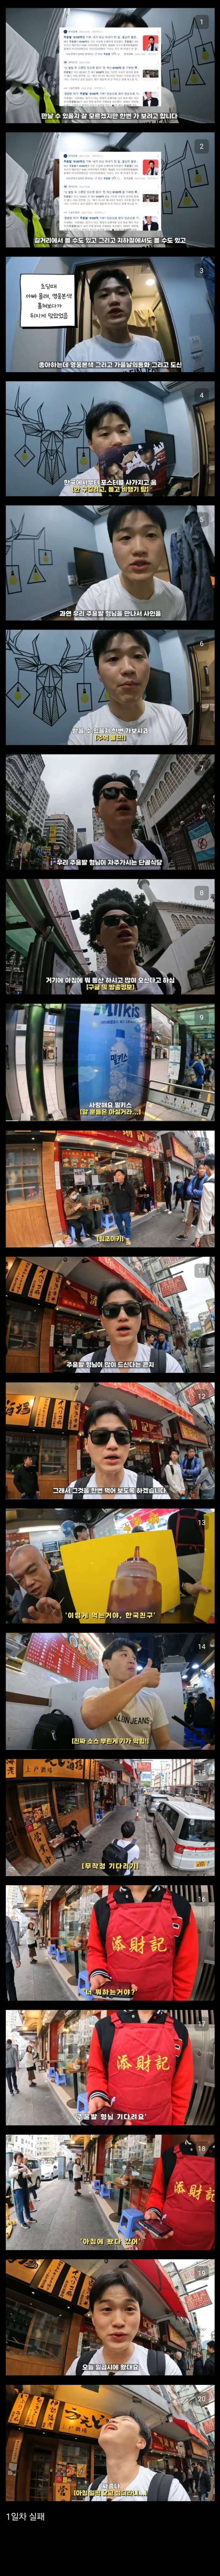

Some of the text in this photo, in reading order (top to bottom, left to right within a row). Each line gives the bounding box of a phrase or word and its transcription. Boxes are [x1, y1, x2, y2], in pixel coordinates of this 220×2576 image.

[48, 889, 74, 949] Cheers Moments
[94, 1004, 140, 1018] Milkis
[111, 1053, 128, 1065] 밀키스
[114, 1714, 130, 1724] KLEIN
[112, 1935, 167, 1955] 添財記
[117, 2054, 170, 2073] 添財記
[47, 2399, 59, 2428] 伊勢海老
